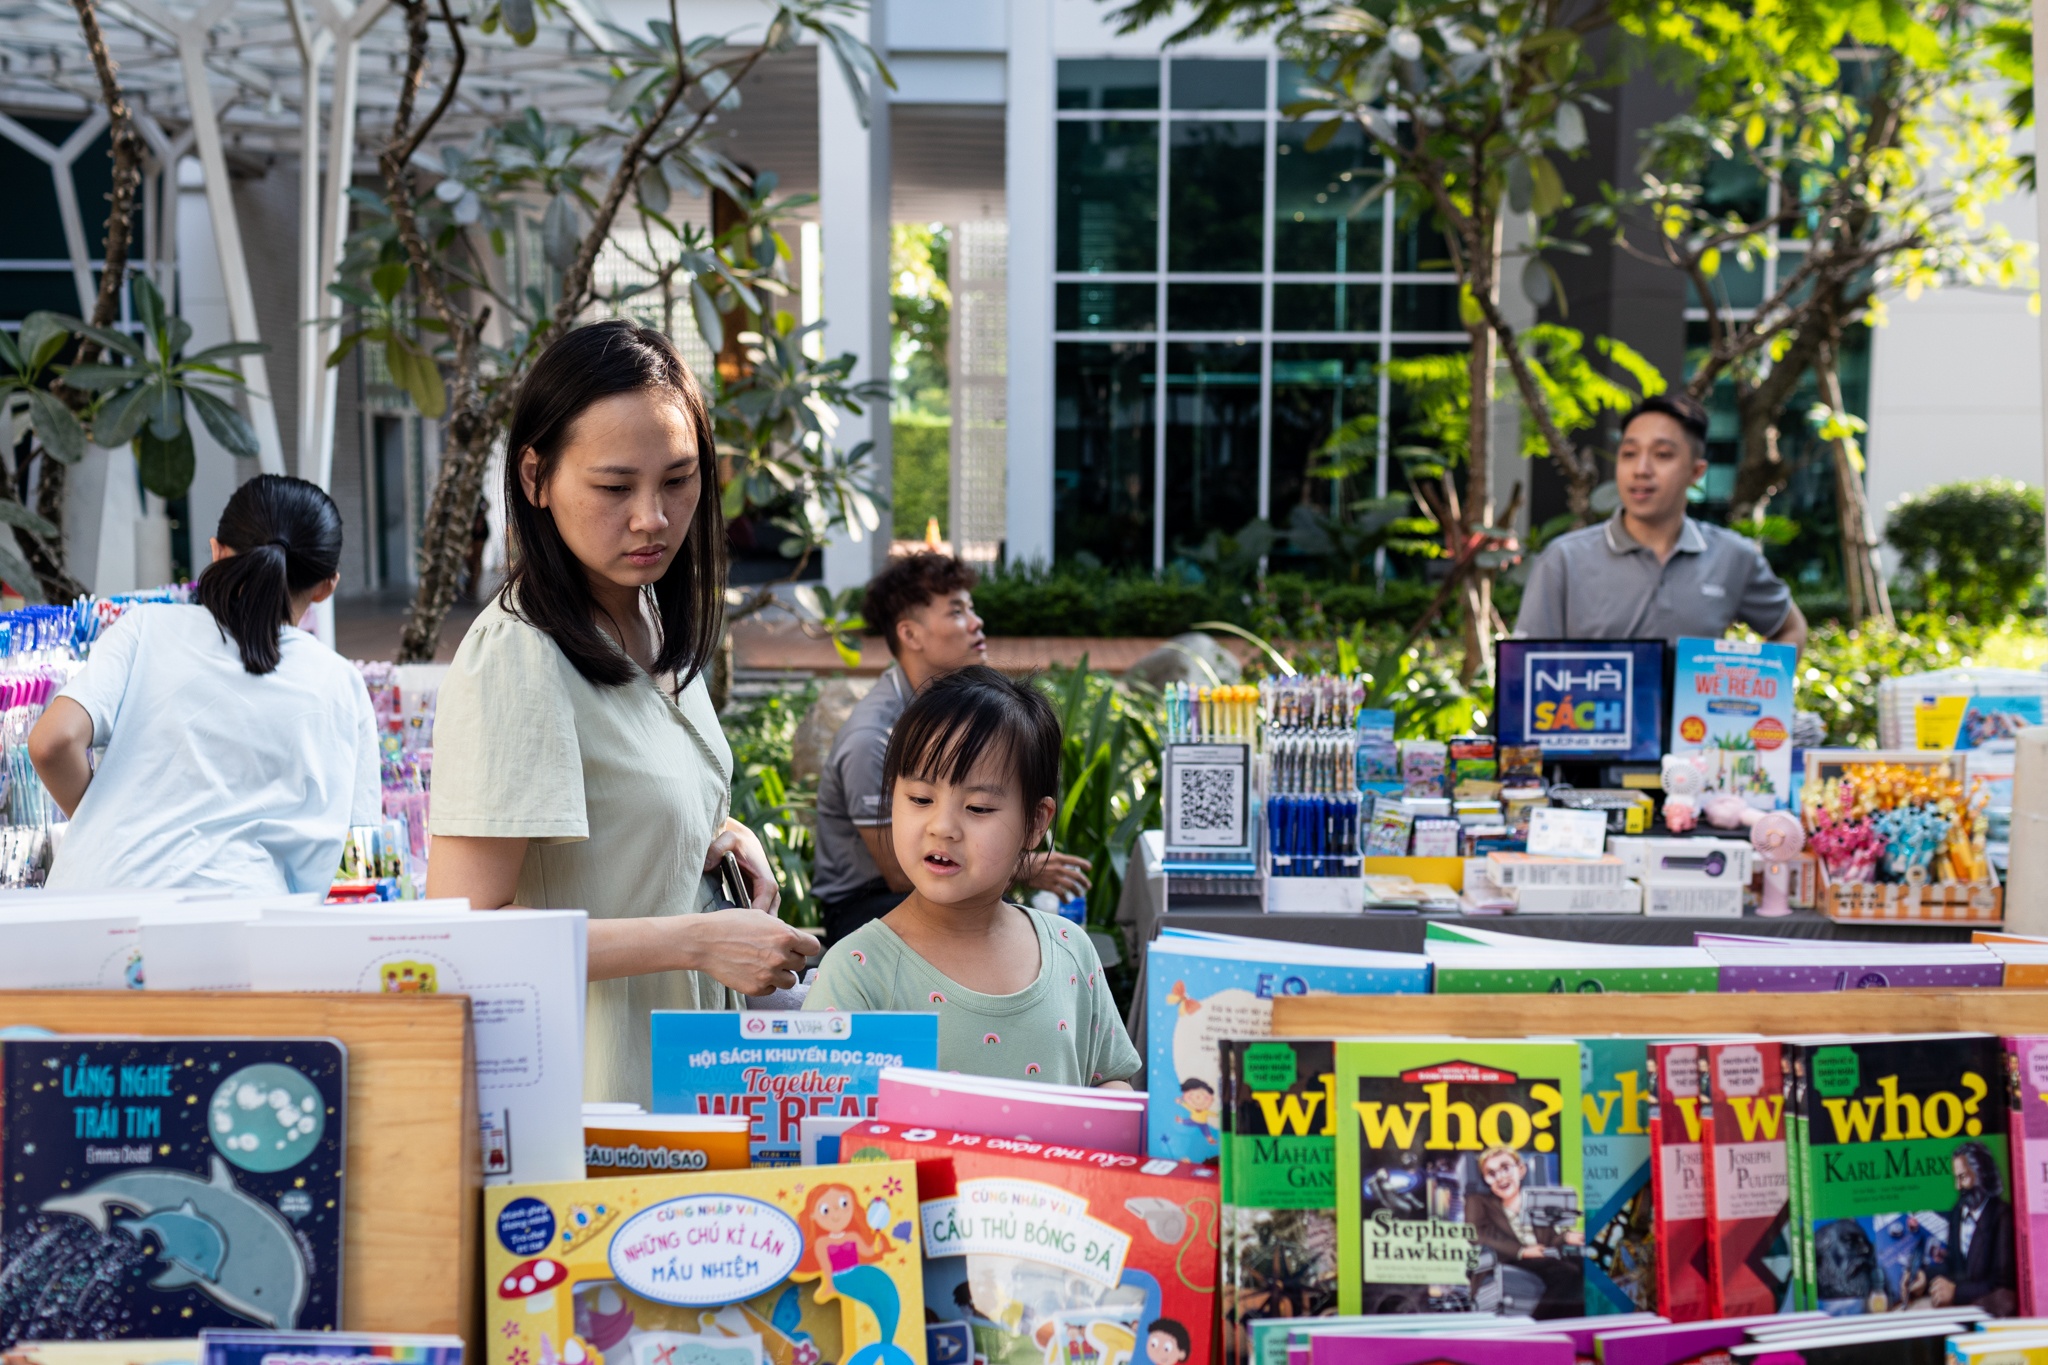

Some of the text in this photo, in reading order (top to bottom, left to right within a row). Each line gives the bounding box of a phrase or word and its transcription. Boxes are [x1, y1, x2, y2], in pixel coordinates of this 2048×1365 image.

[1535, 662, 1622, 692] NHÀ
[1694, 674, 1778, 699] WE READ
[1534, 694, 1621, 731] SÁCH
[689, 1045, 903, 1069] HỘI SÁCH KHUYẾN ĐỌC 2026
[120, 1064, 174, 1097] NGHE
[742, 1067, 850, 1101] Together
[73, 1100, 161, 1139] TRÁI TIM
[1351, 1081, 1564, 1153] who?
[1822, 1071, 1988, 1145] who?
[616, 1145, 645, 1168] HỎI
[647, 1147, 667, 1169] VÌ
[670, 1149, 707, 1170] SAO
[986, 1138, 1043, 1154] BÓNG
[1252, 1138, 1333, 1165] MAHAT
[1728, 1148, 1772, 1175] JOSEPH
[1823, 1147, 1951, 1184] KARL MARX
[1287, 1165, 1333, 1188] GAN
[1737, 1167, 1789, 1190] PULITZE
[657, 1203, 694, 1223] CÙNG
[737, 1203, 758, 1216] VAI
[972, 1189, 1008, 1204] CÙNG
[1050, 1200, 1073, 1217] VAI
[933, 1207, 1115, 1271] CẦU THỦ BÓNG ĐÁ
[1372, 1210, 1477, 1243] Stephen
[623, 1230, 681, 1263] NHỮNG
[687, 1221, 720, 1246] CHÚ
[751, 1229, 785, 1257] LÂN
[1372, 1241, 1481, 1269] Hawking
[701, 1254, 759, 1283] NHIỆM
